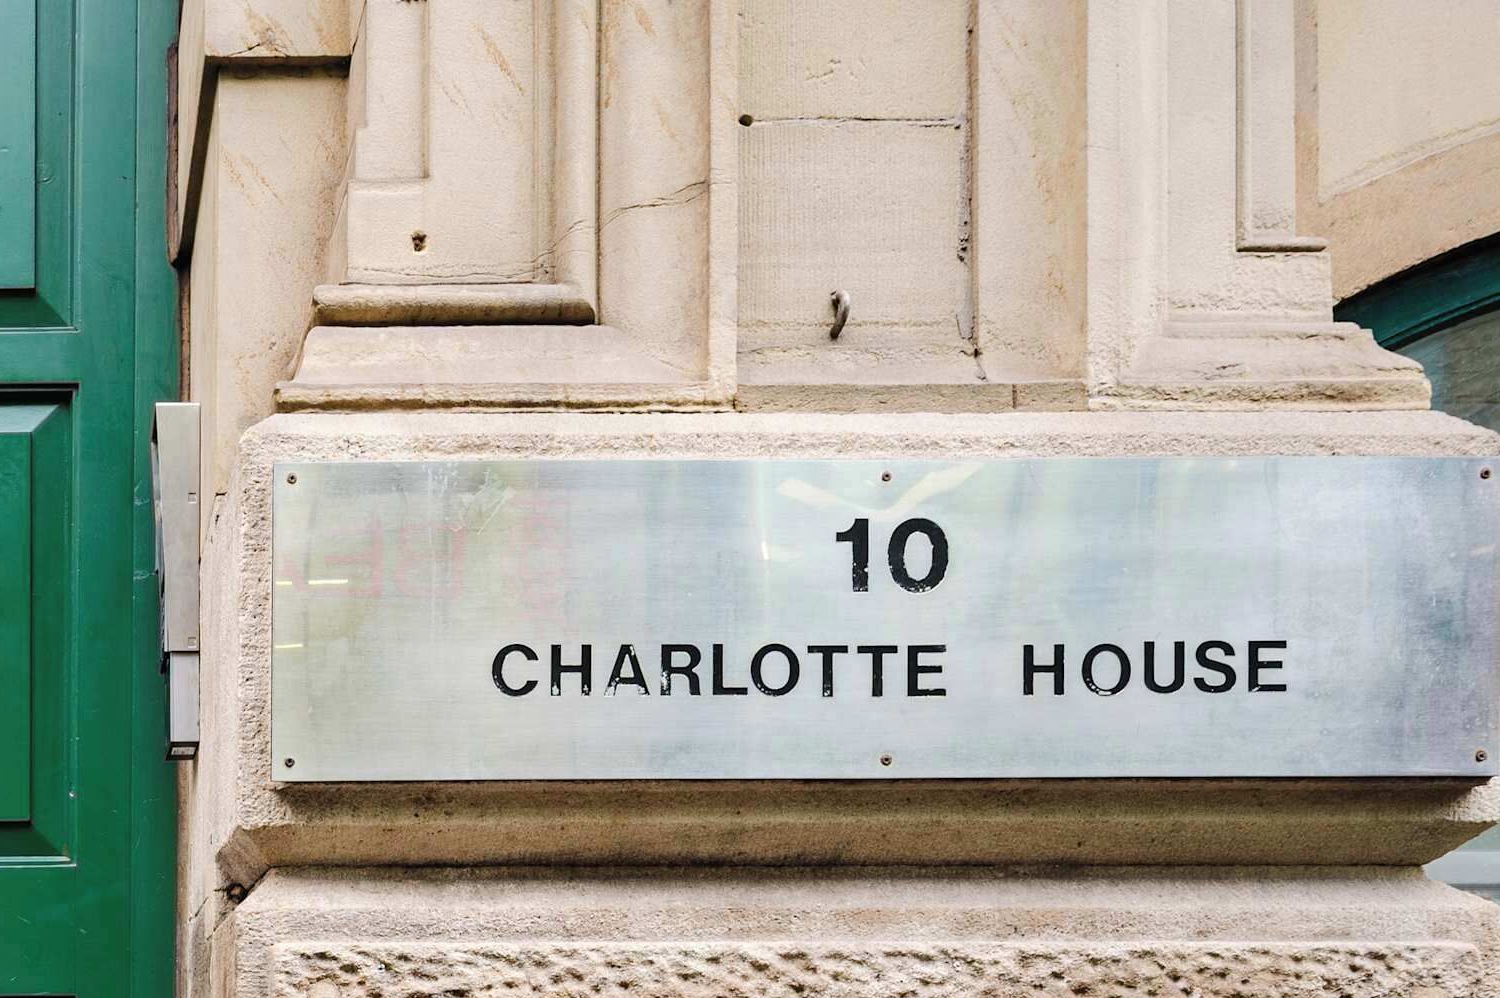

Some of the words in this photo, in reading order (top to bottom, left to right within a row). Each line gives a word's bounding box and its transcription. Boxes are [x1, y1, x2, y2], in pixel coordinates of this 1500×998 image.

[835, 518, 949, 593] 10
[491, 641, 948, 698] CHARLOTTE
[1023, 640, 1287, 696] HOUSE
